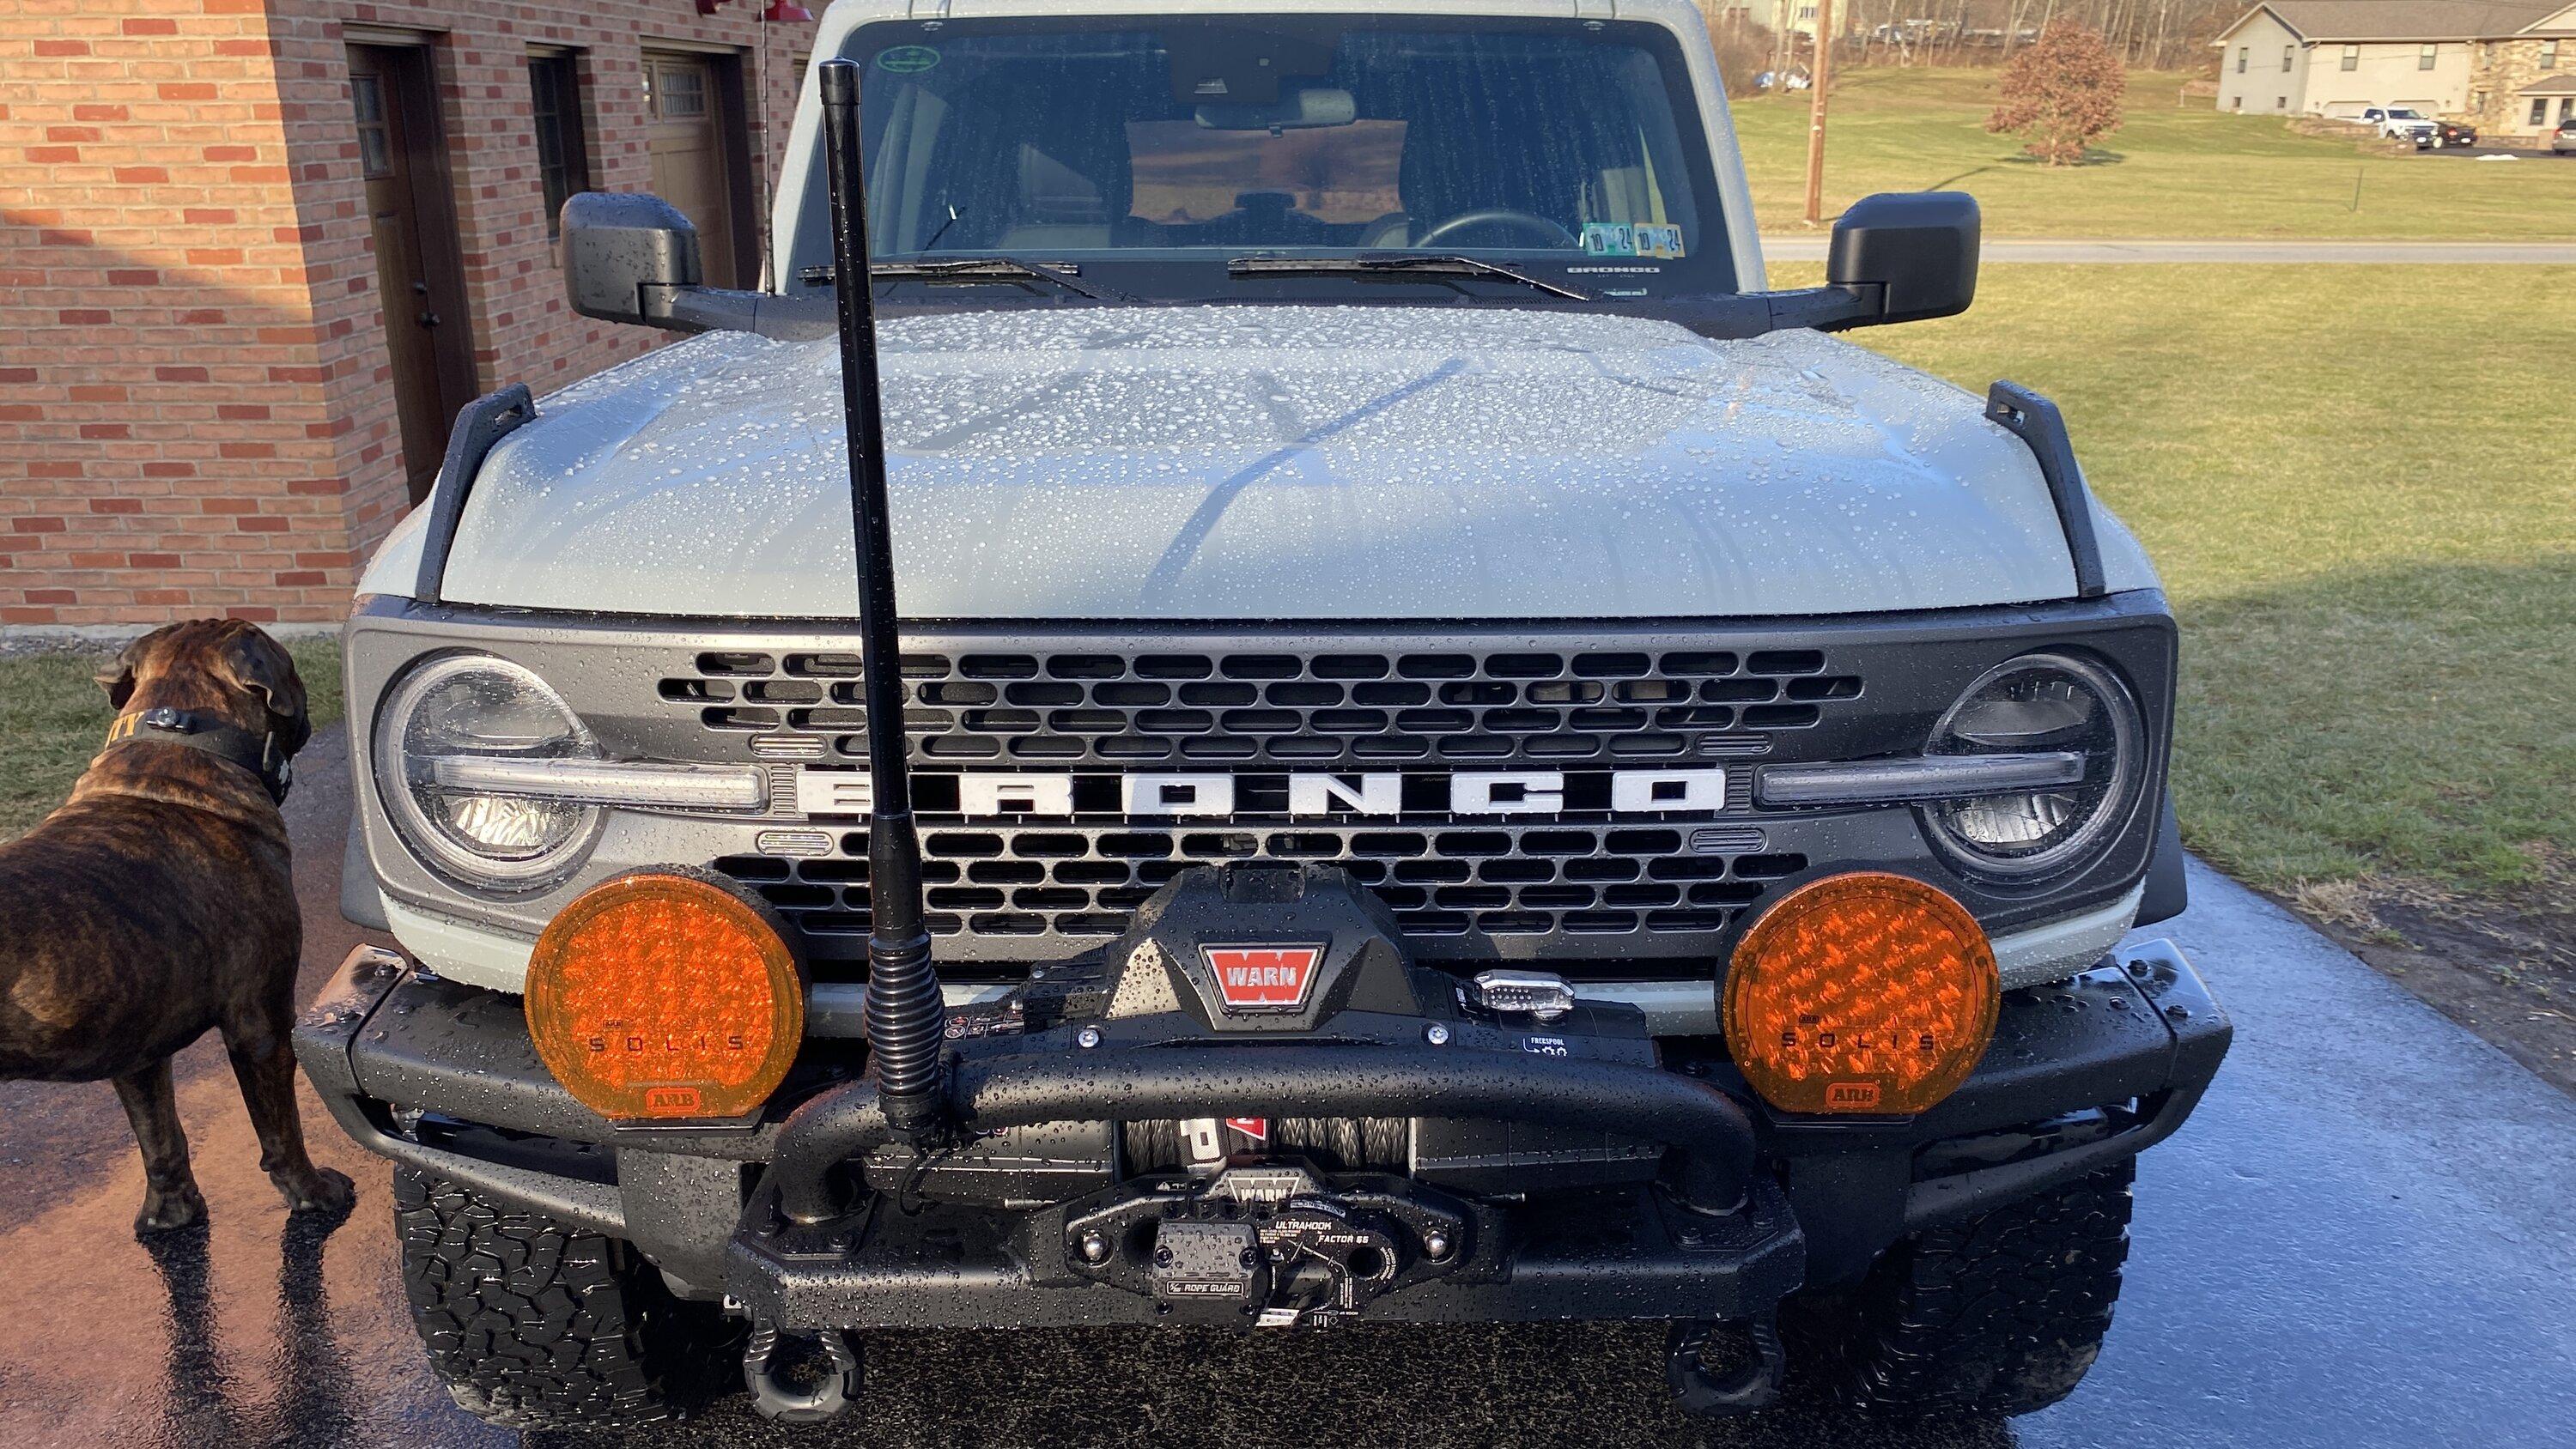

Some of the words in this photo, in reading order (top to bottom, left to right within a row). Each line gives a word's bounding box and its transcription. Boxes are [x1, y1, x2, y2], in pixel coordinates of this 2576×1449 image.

[796, 767, 1726, 814] BRONCO
[1226, 967, 1297, 986] WARN
[589, 1035, 744, 1052] SOLIS
[1531, 1037, 1564, 1046] FREESPOOL
[1782, 1032, 1934, 1050] SOLIS
[654, 1093, 694, 1106] ARB
[1832, 1088, 1874, 1102] ARB
[1241, 1188, 1287, 1202] WARN
[1275, 1221, 1332, 1231] ULTRAHOOK
[1318, 1234, 1354, 1244] FACTOR
[1184, 1284, 1209, 1293] ROPE
[1210, 1283, 1240, 1293] GUARD
